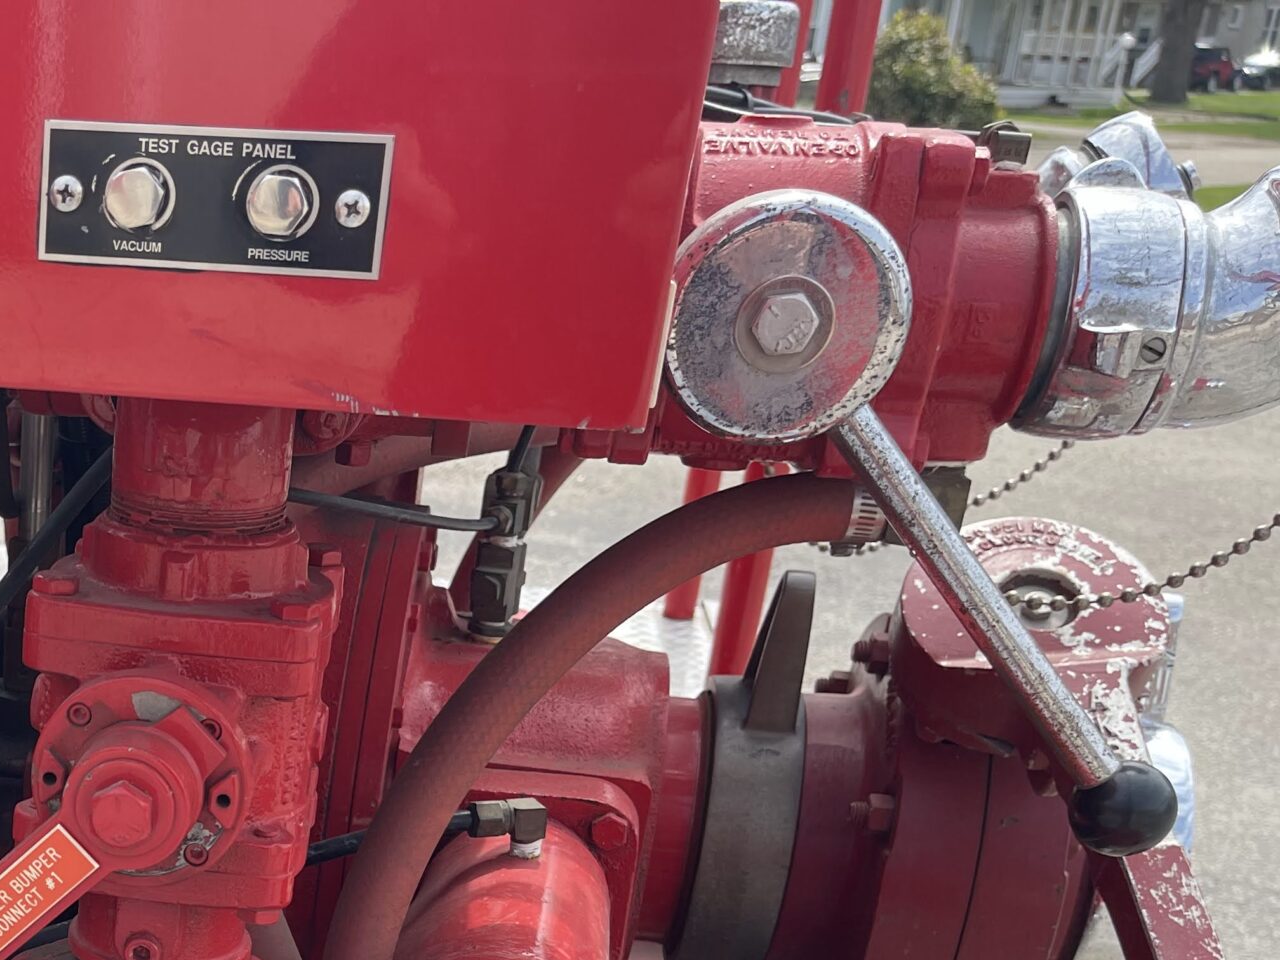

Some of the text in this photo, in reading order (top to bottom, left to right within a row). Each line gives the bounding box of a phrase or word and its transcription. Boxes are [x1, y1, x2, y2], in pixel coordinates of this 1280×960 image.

[138, 137, 297, 160] TEST GAGE PANEL
[112, 239, 162, 253] VACUUM
[247, 248, 310, 263] PRESSURE
[9, 846, 62, 895] BUMPER
[45, 871, 64, 891] #1
